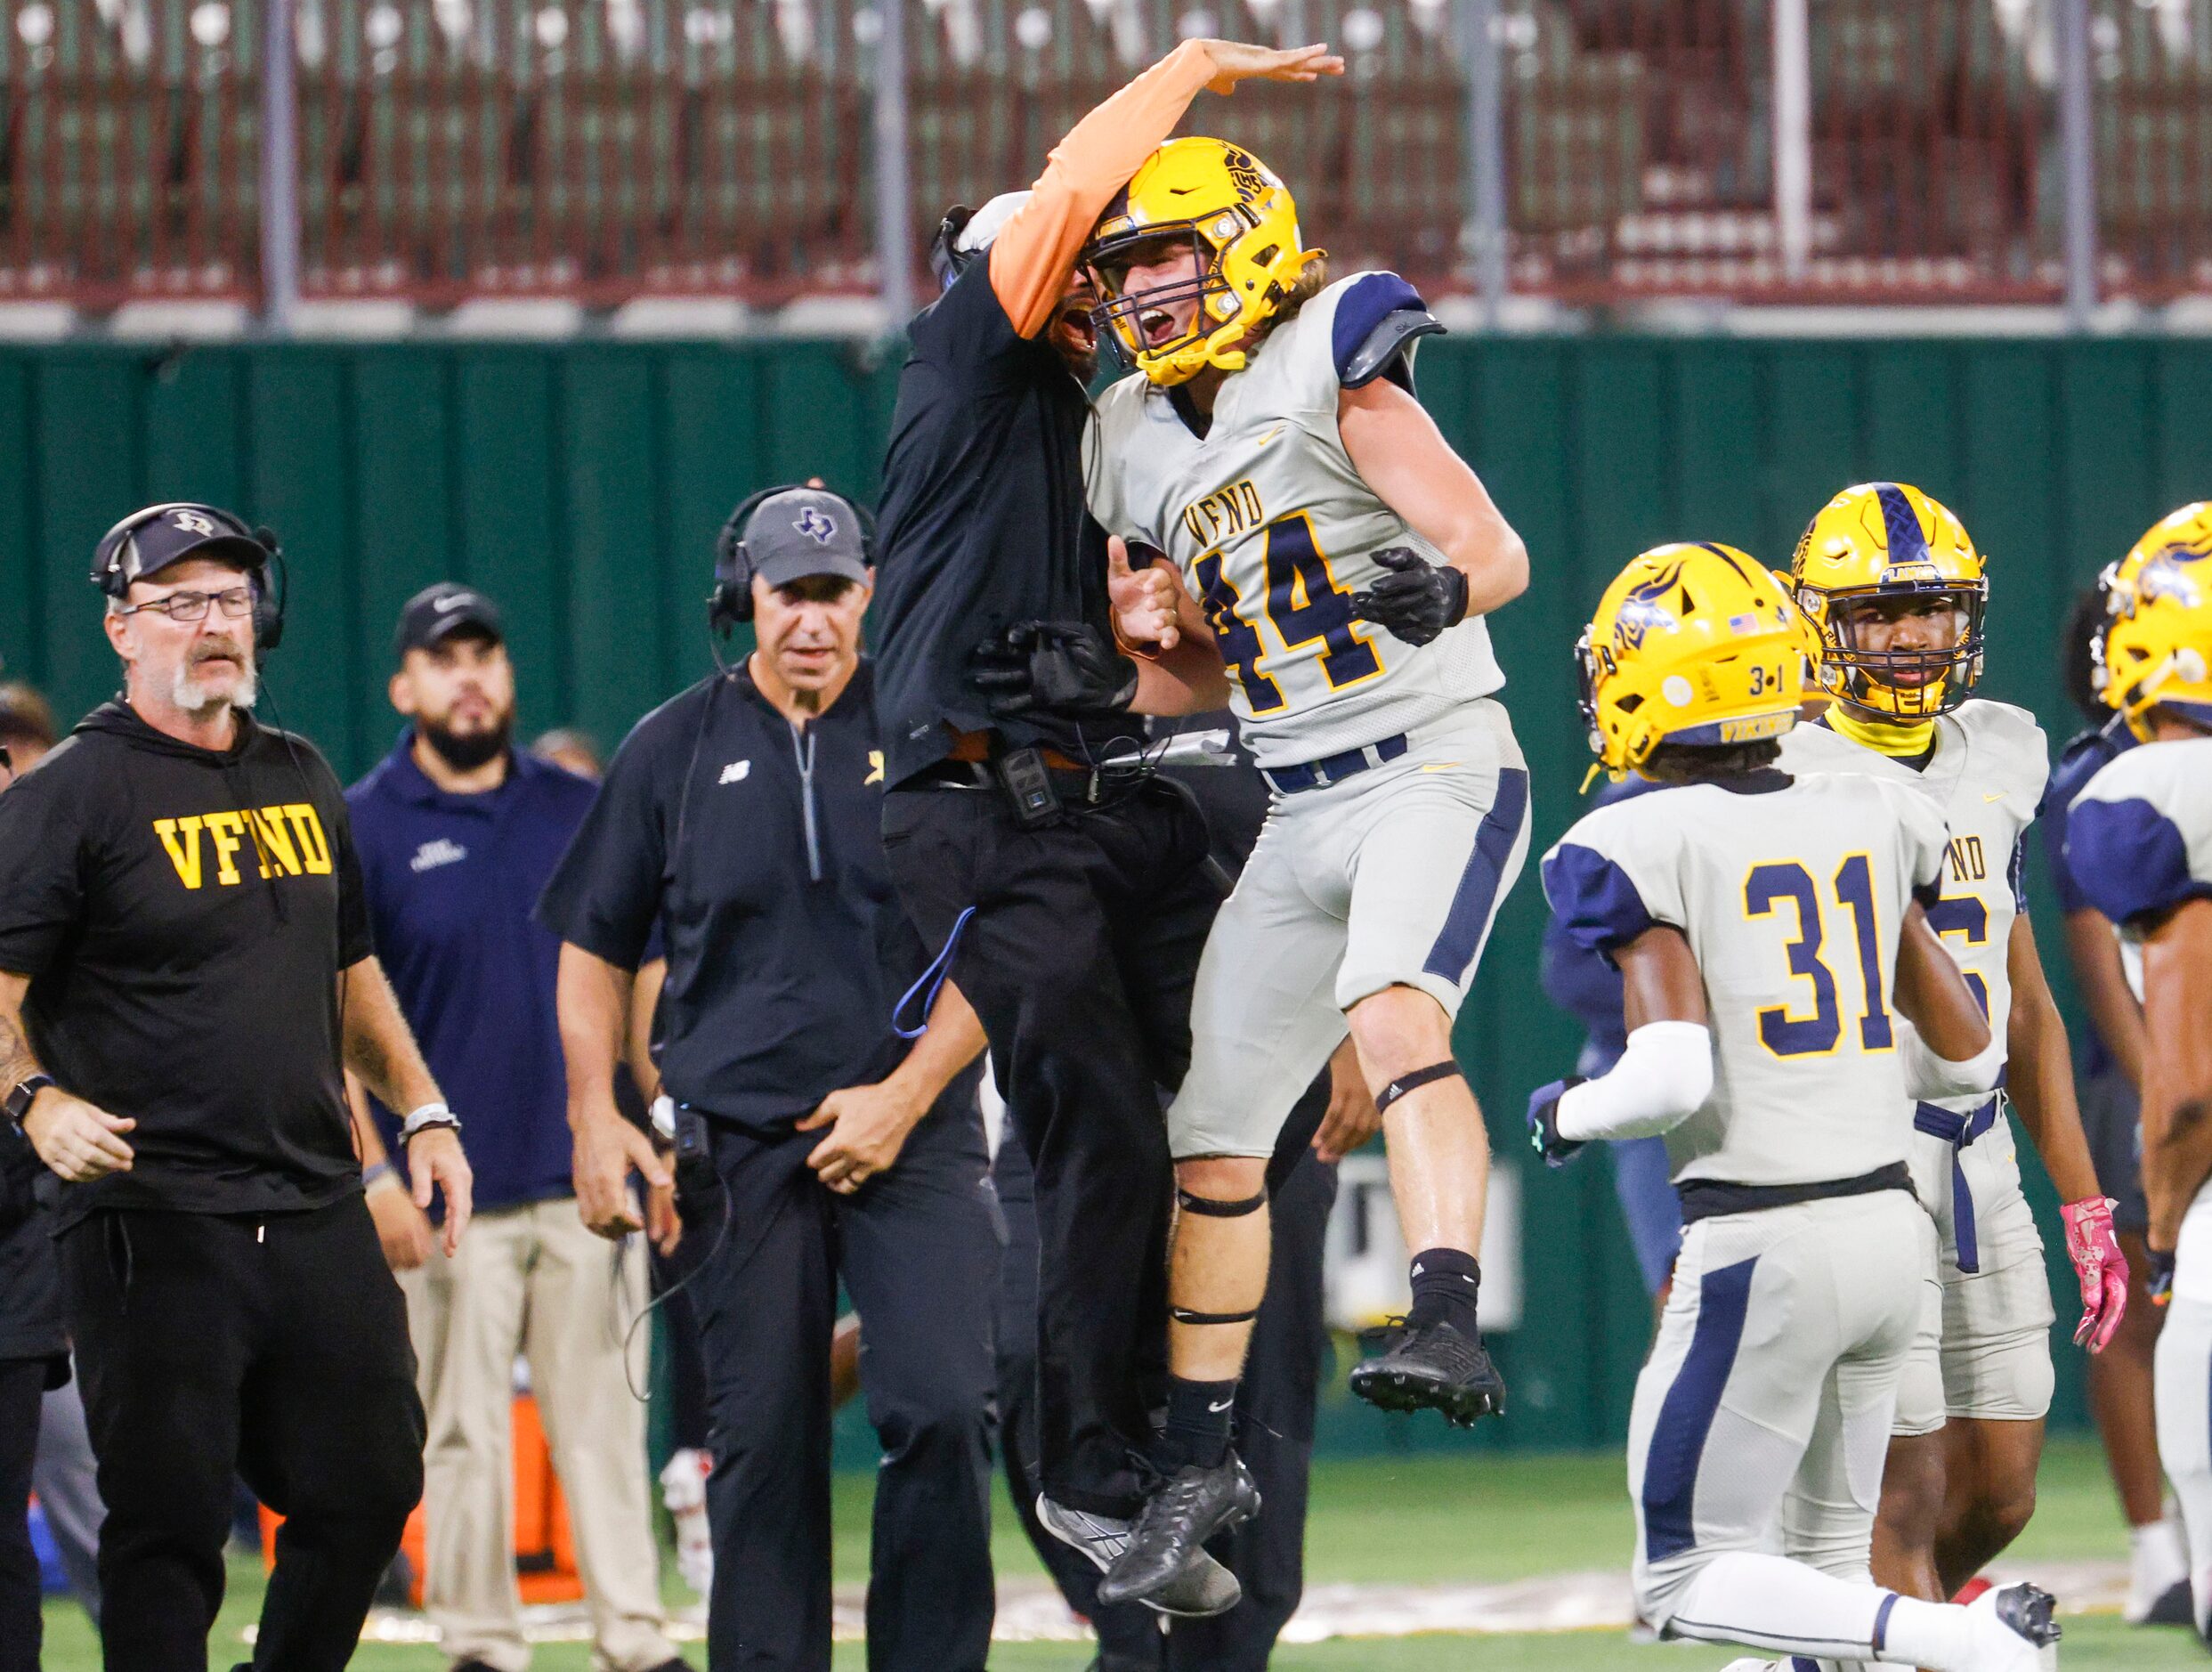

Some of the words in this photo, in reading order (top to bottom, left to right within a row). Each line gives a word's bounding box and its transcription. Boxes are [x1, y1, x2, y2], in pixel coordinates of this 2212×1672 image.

[1184, 478, 1264, 548] VFND
[1191, 508, 1387, 717] 44
[152, 803, 332, 889] VFND
[1946, 835, 1987, 882] ND
[1741, 848, 1897, 1061] 31
